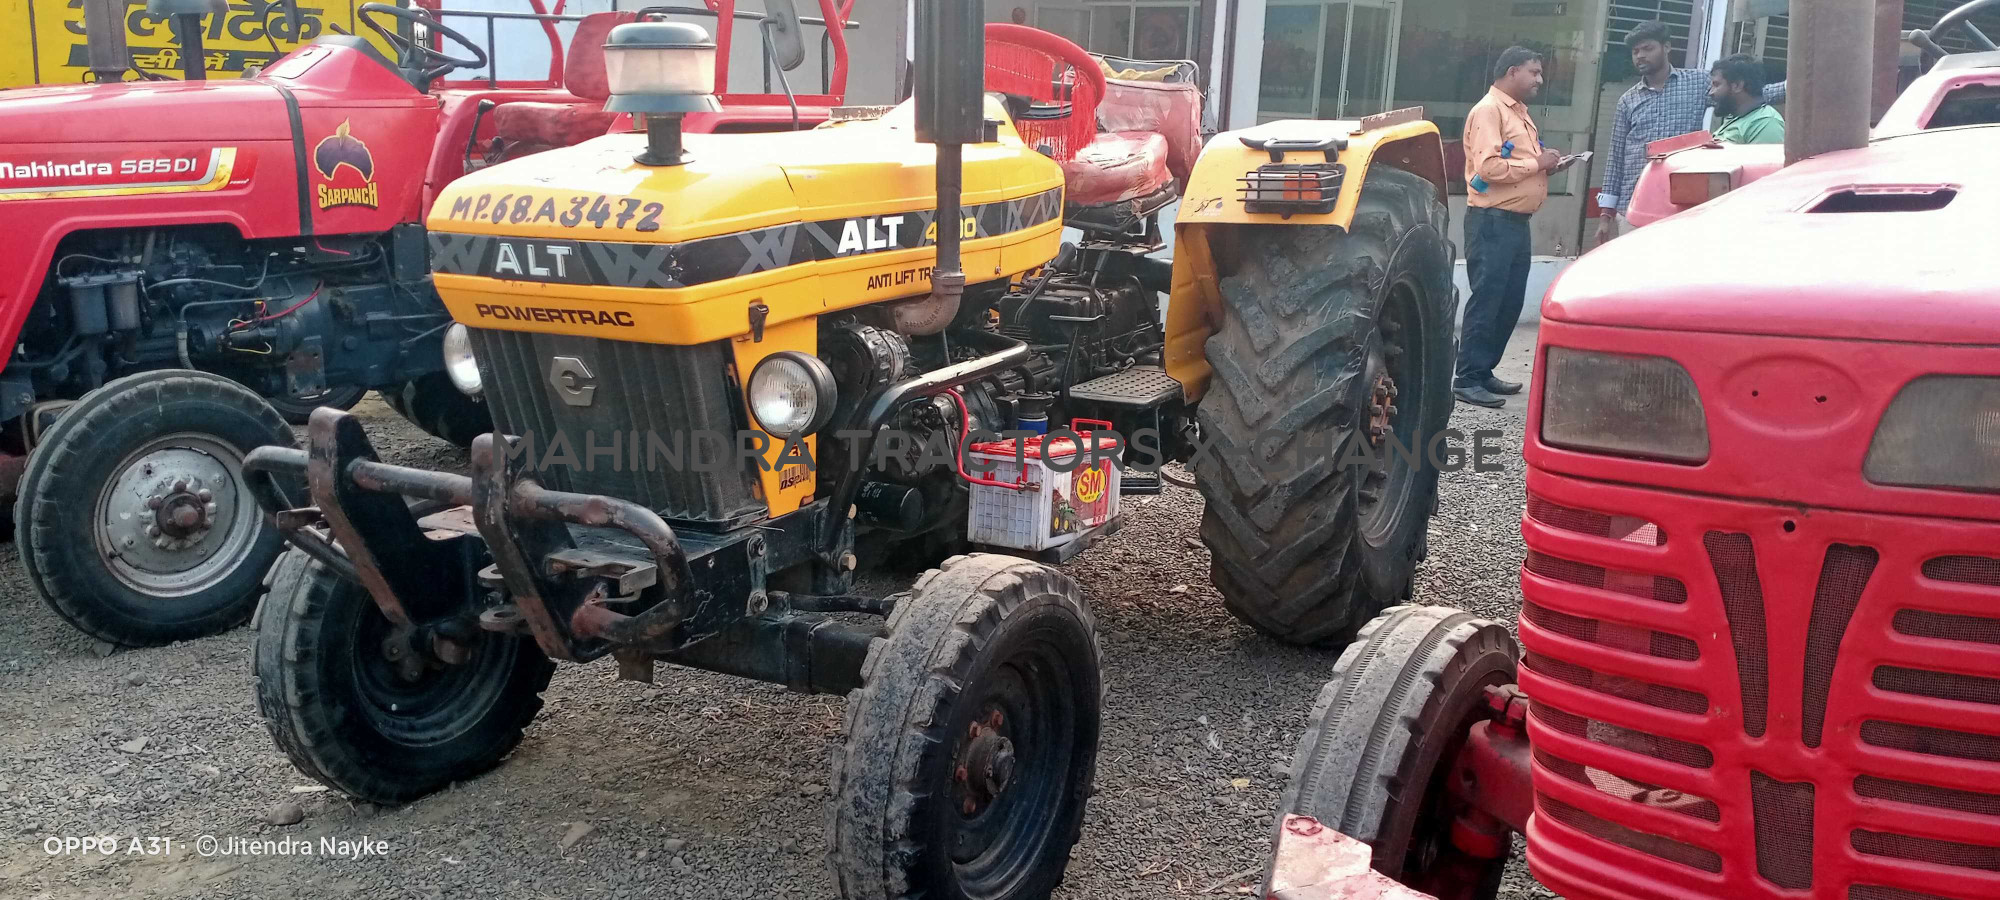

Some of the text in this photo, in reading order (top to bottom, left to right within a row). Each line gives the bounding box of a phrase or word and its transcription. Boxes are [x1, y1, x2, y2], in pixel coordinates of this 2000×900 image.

[318, 182, 379, 209] SARPANCH
[837, 215, 977, 254] ALT 40
[495, 242, 573, 278] ALT
[866, 273, 892, 290] ANTI
[895, 268, 915, 286] LIFT
[475, 303, 635, 327] POWERTRAC
[1079, 471, 1102, 496] SM
